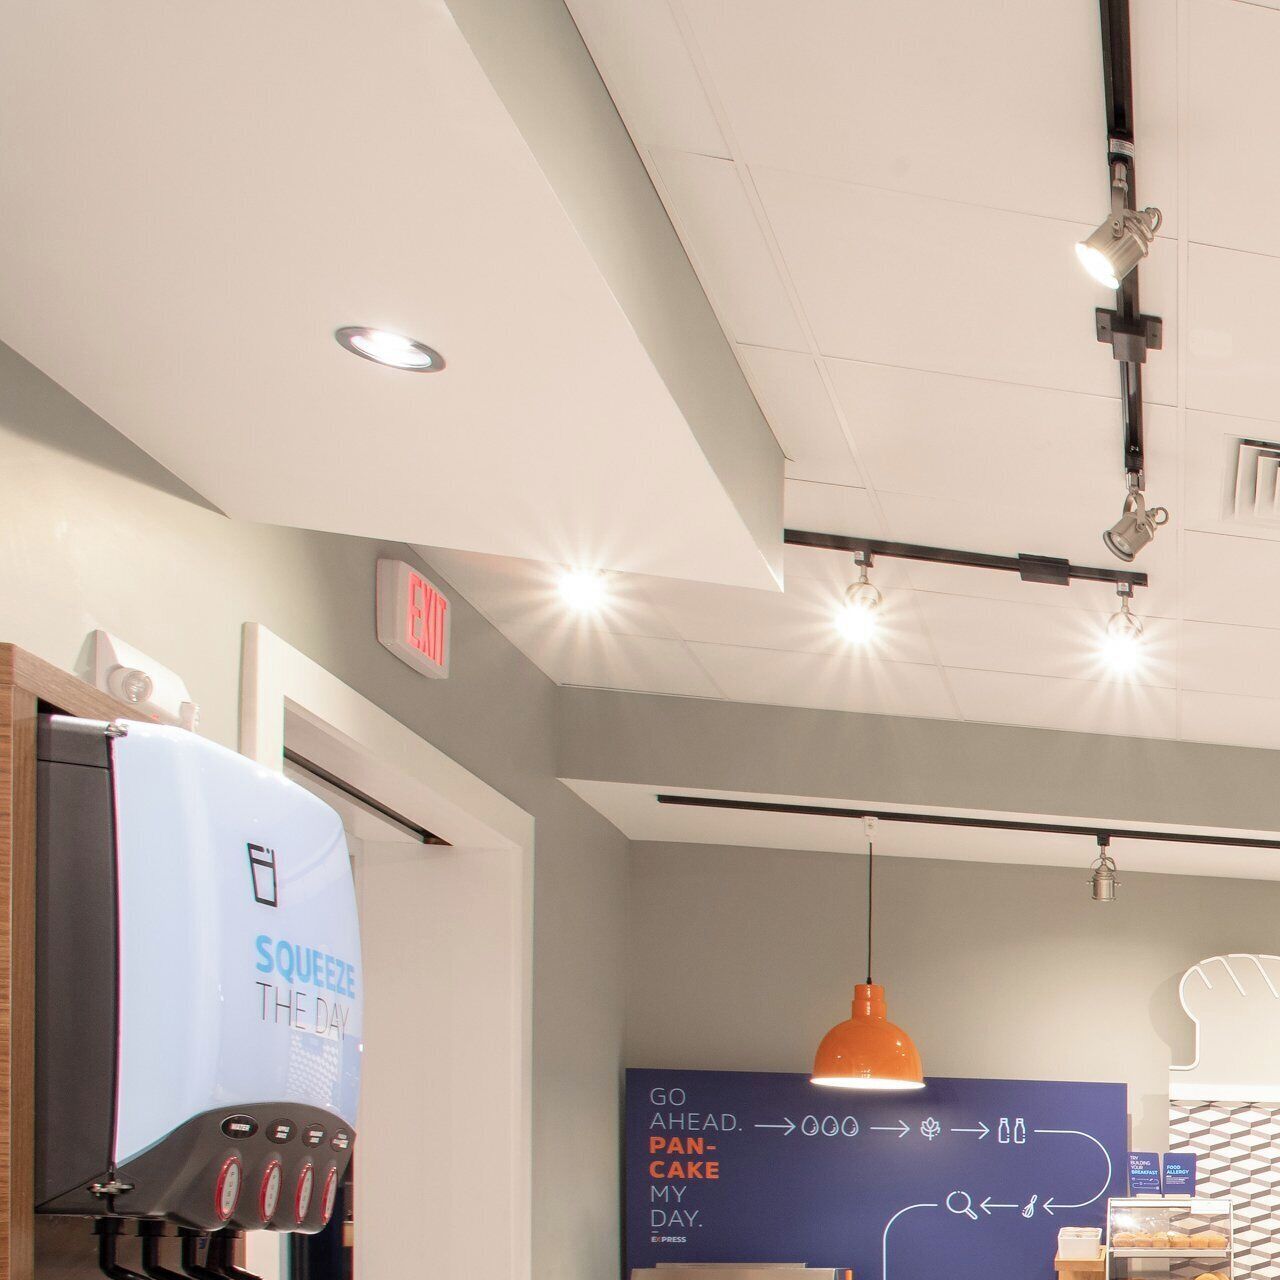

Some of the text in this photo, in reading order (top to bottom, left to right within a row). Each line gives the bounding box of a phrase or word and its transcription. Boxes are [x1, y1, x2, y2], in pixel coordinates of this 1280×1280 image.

[406, 571, 447, 666] EXIT
[255, 934, 355, 999] SQUEEZE
[256, 981, 349, 1040] THE DAY
[650, 1087, 686, 1106] GO
[649, 1112, 742, 1132] AHEAD.
[649, 1136, 716, 1155] PAN-
[649, 1160, 720, 1179] CAKE
[651, 1185, 687, 1203] MY
[651, 1209, 702, 1228] DAY.
